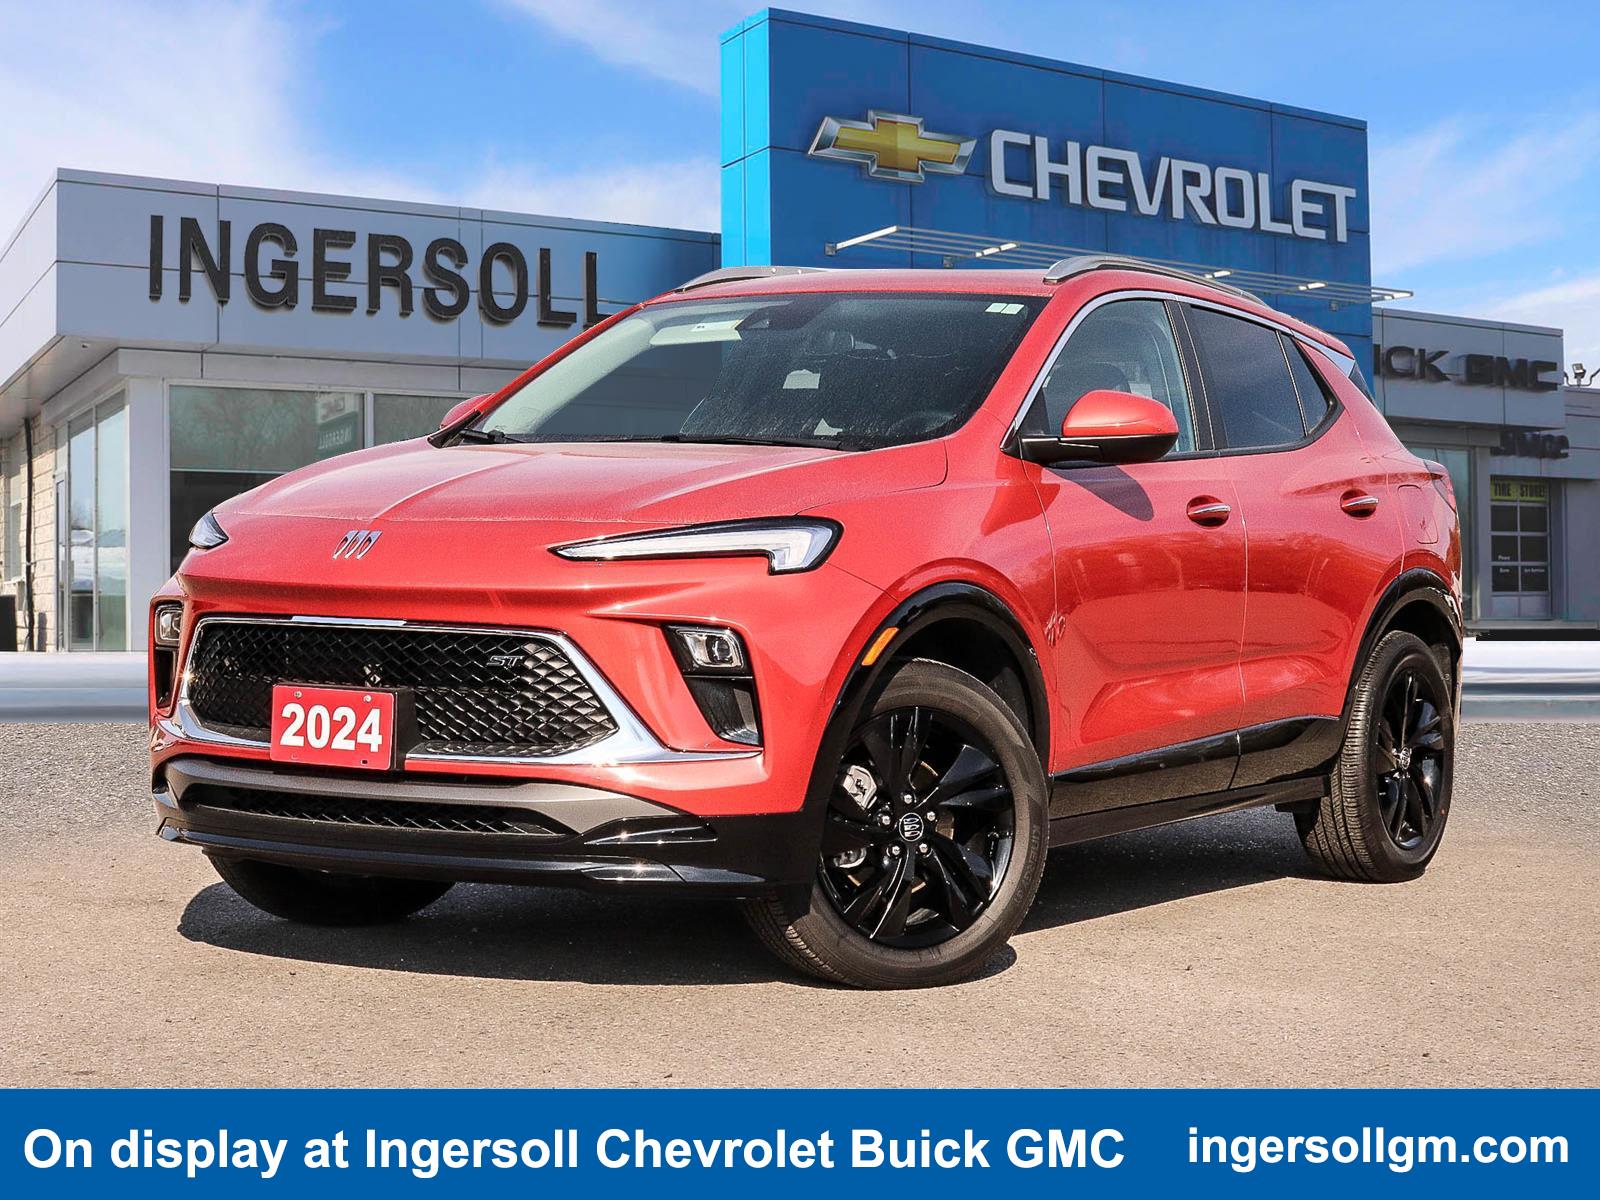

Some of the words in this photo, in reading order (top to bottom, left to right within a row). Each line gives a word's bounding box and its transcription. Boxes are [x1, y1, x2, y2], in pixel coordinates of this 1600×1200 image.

[989, 129, 1356, 243] CHEVROLET
[149, 214, 612, 329] INGERSOLL
[1464, 353, 1557, 391] GMC
[486, 655, 524, 667] ST
[279, 702, 383, 752] 2024
